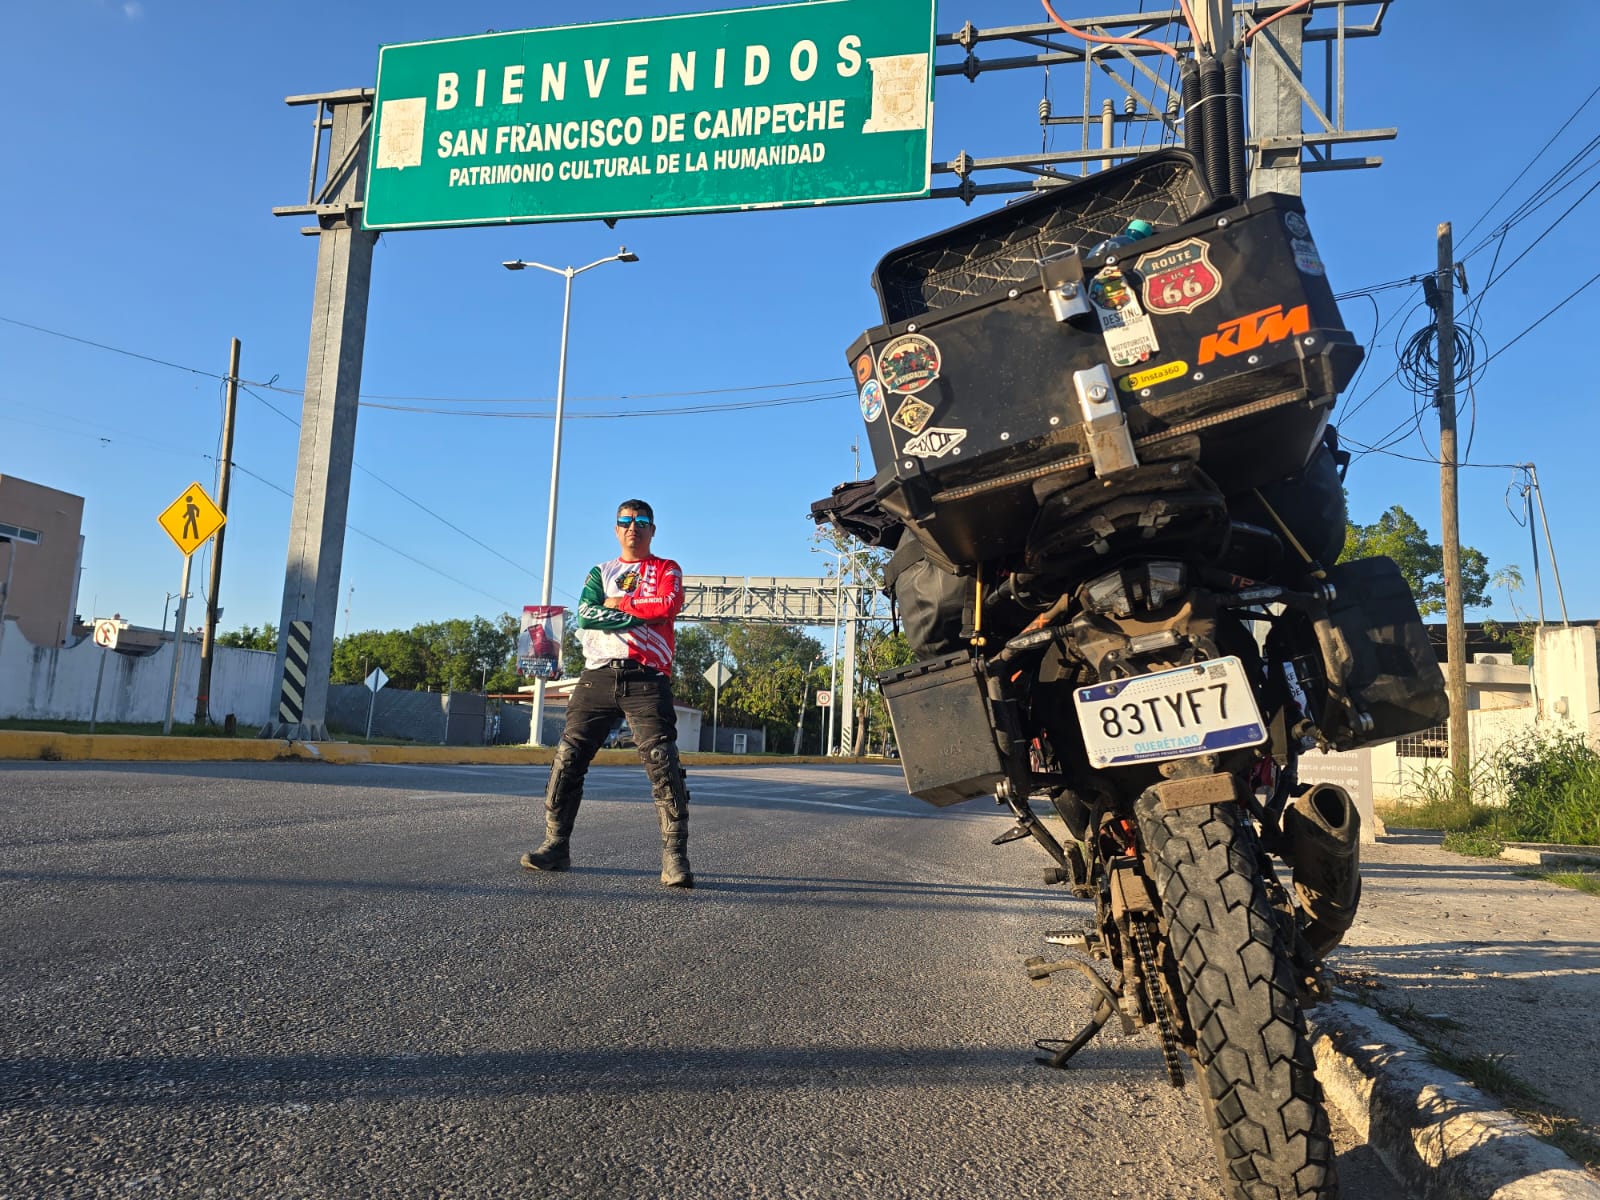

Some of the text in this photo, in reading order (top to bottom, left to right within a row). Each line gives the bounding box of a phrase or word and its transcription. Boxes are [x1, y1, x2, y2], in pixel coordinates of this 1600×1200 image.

[436, 34, 863, 111] BIENVENIDOS
[437, 98, 846, 159] SAN FRANCISCO DE CAMPECHE
[448, 142, 826, 188] PATRIMONIO CULTURAL DE LA HUMANIDAD
[1151, 250, 1193, 271] ROUTE
[1162, 277, 1203, 305] 66
[1198, 304, 1310, 365] KTM
[1114, 351, 1125, 362] EN
[1141, 365, 1180, 383] Insta360
[1082, 690, 1091, 700] T
[1099, 683, 1228, 739] 83TYF7
[1134, 734, 1200, 753] QUERÉTARO
